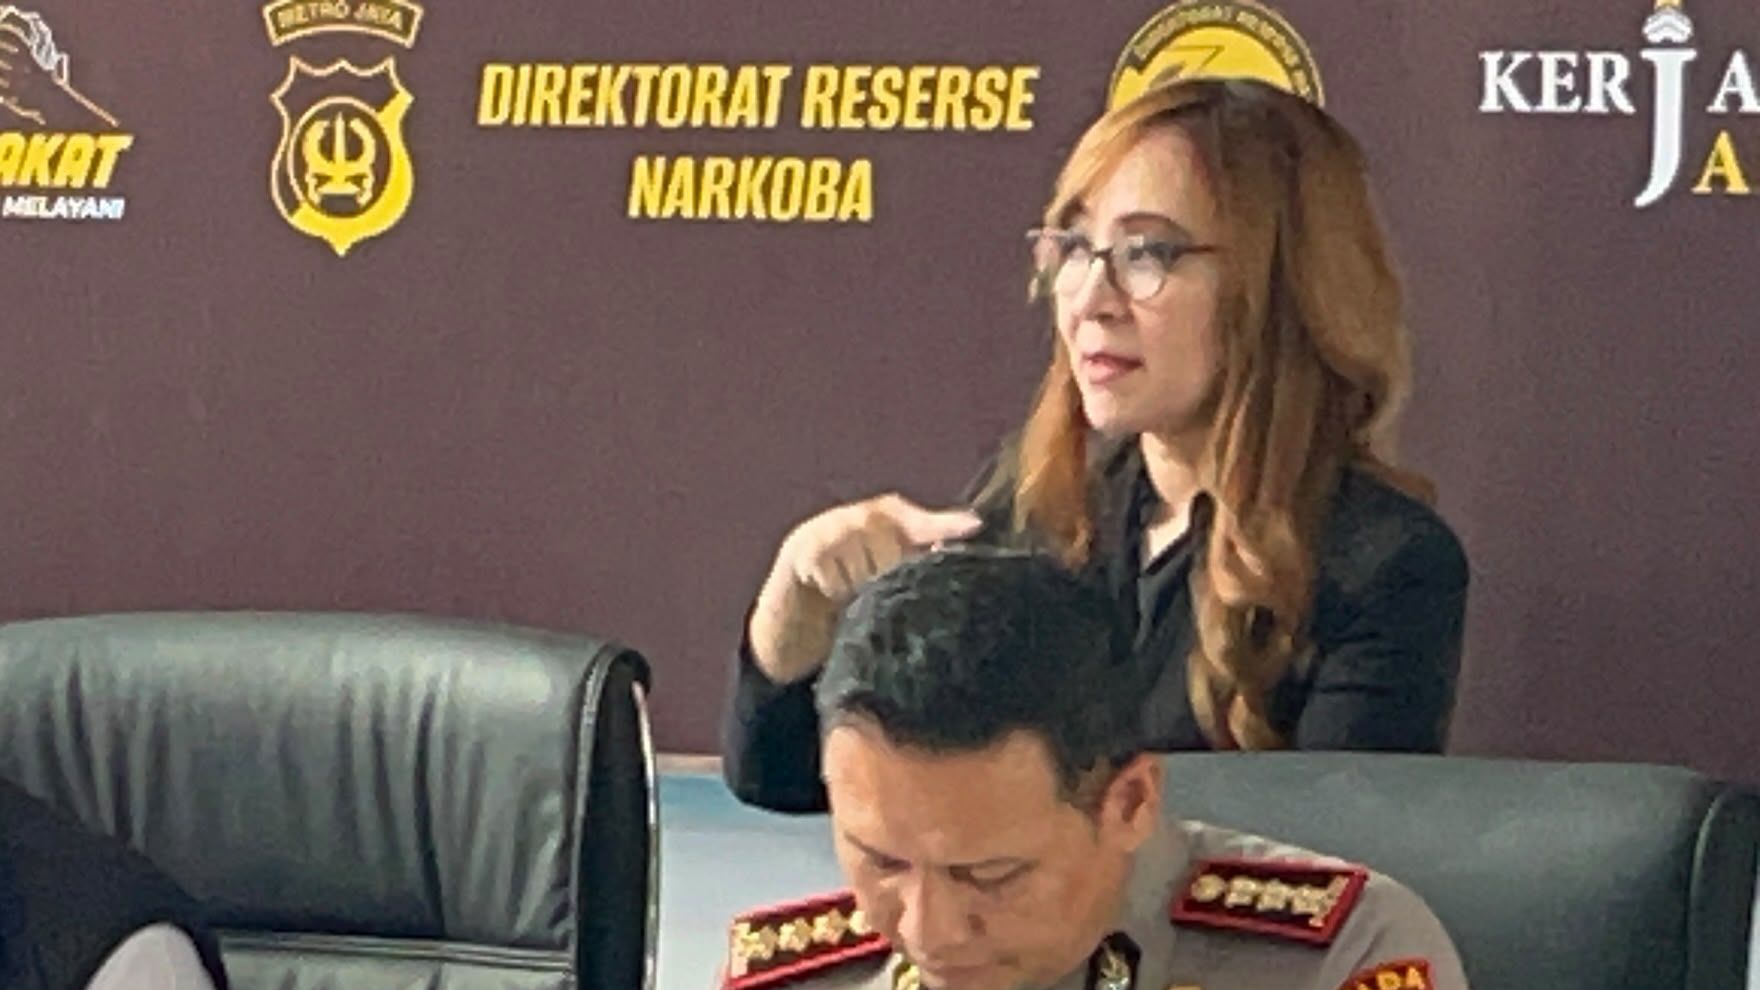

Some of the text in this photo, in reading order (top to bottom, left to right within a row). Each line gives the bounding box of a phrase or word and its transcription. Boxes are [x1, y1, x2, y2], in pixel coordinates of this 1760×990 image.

[477, 65, 1039, 132] DIREKTORAT RESERSE
[2, 195, 126, 220] MELAYANI
[628, 156, 874, 222] NARKOBA
